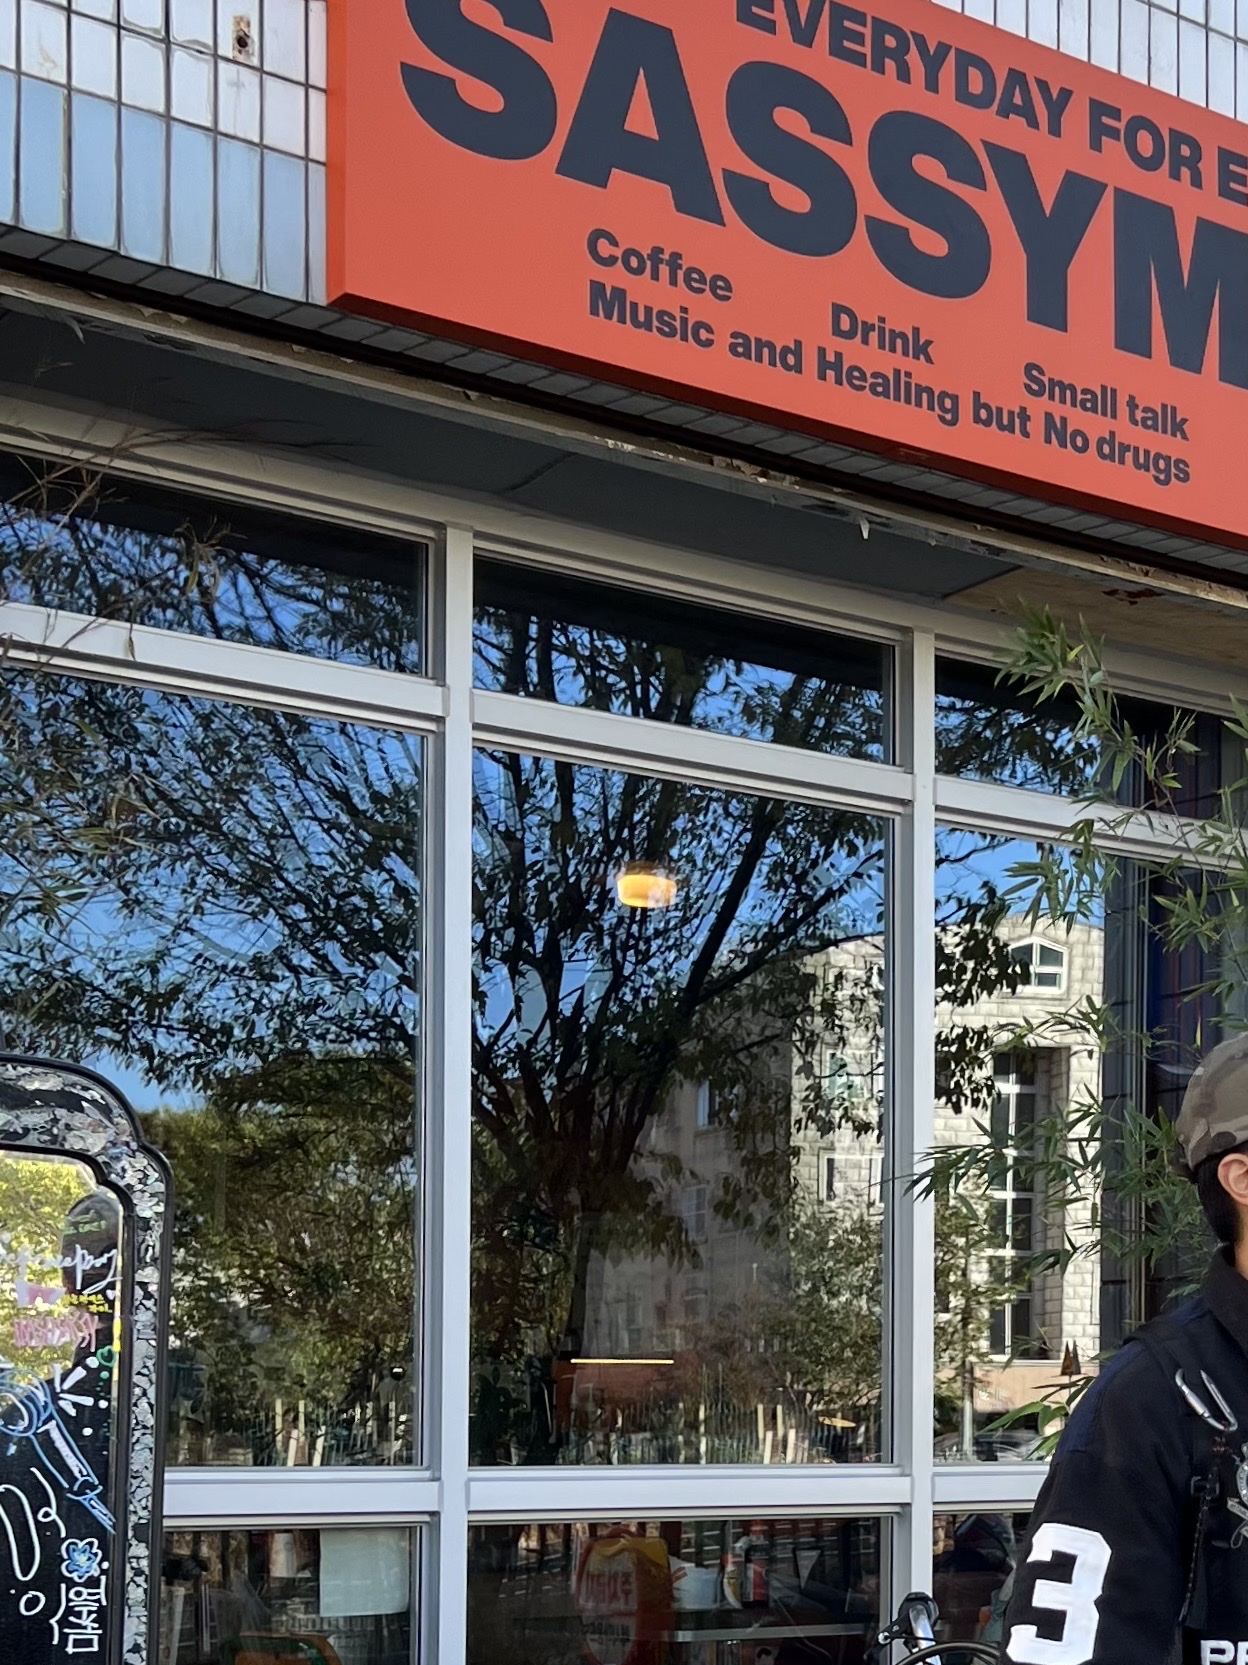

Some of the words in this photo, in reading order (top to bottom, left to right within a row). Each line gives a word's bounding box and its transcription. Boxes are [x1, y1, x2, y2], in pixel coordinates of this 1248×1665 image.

[736, 0, 1073, 138] EVERYDAY
[1089, 98, 1202, 190] FOR
[587, 229, 733, 301] Coffee
[832, 303, 934, 364] Drink
[589, 280, 715, 348] Music
[728, 331, 803, 374] and
[817, 347, 960, 427] Healing
[972, 391, 1031, 438] but
[1044, 412, 1089, 454] No
[1096, 431, 1191, 486] drugs
[1024, 363, 1118, 420] Small
[1126, 395, 1189, 440] talk
[62, 1574, 107, 1656] 마세요
